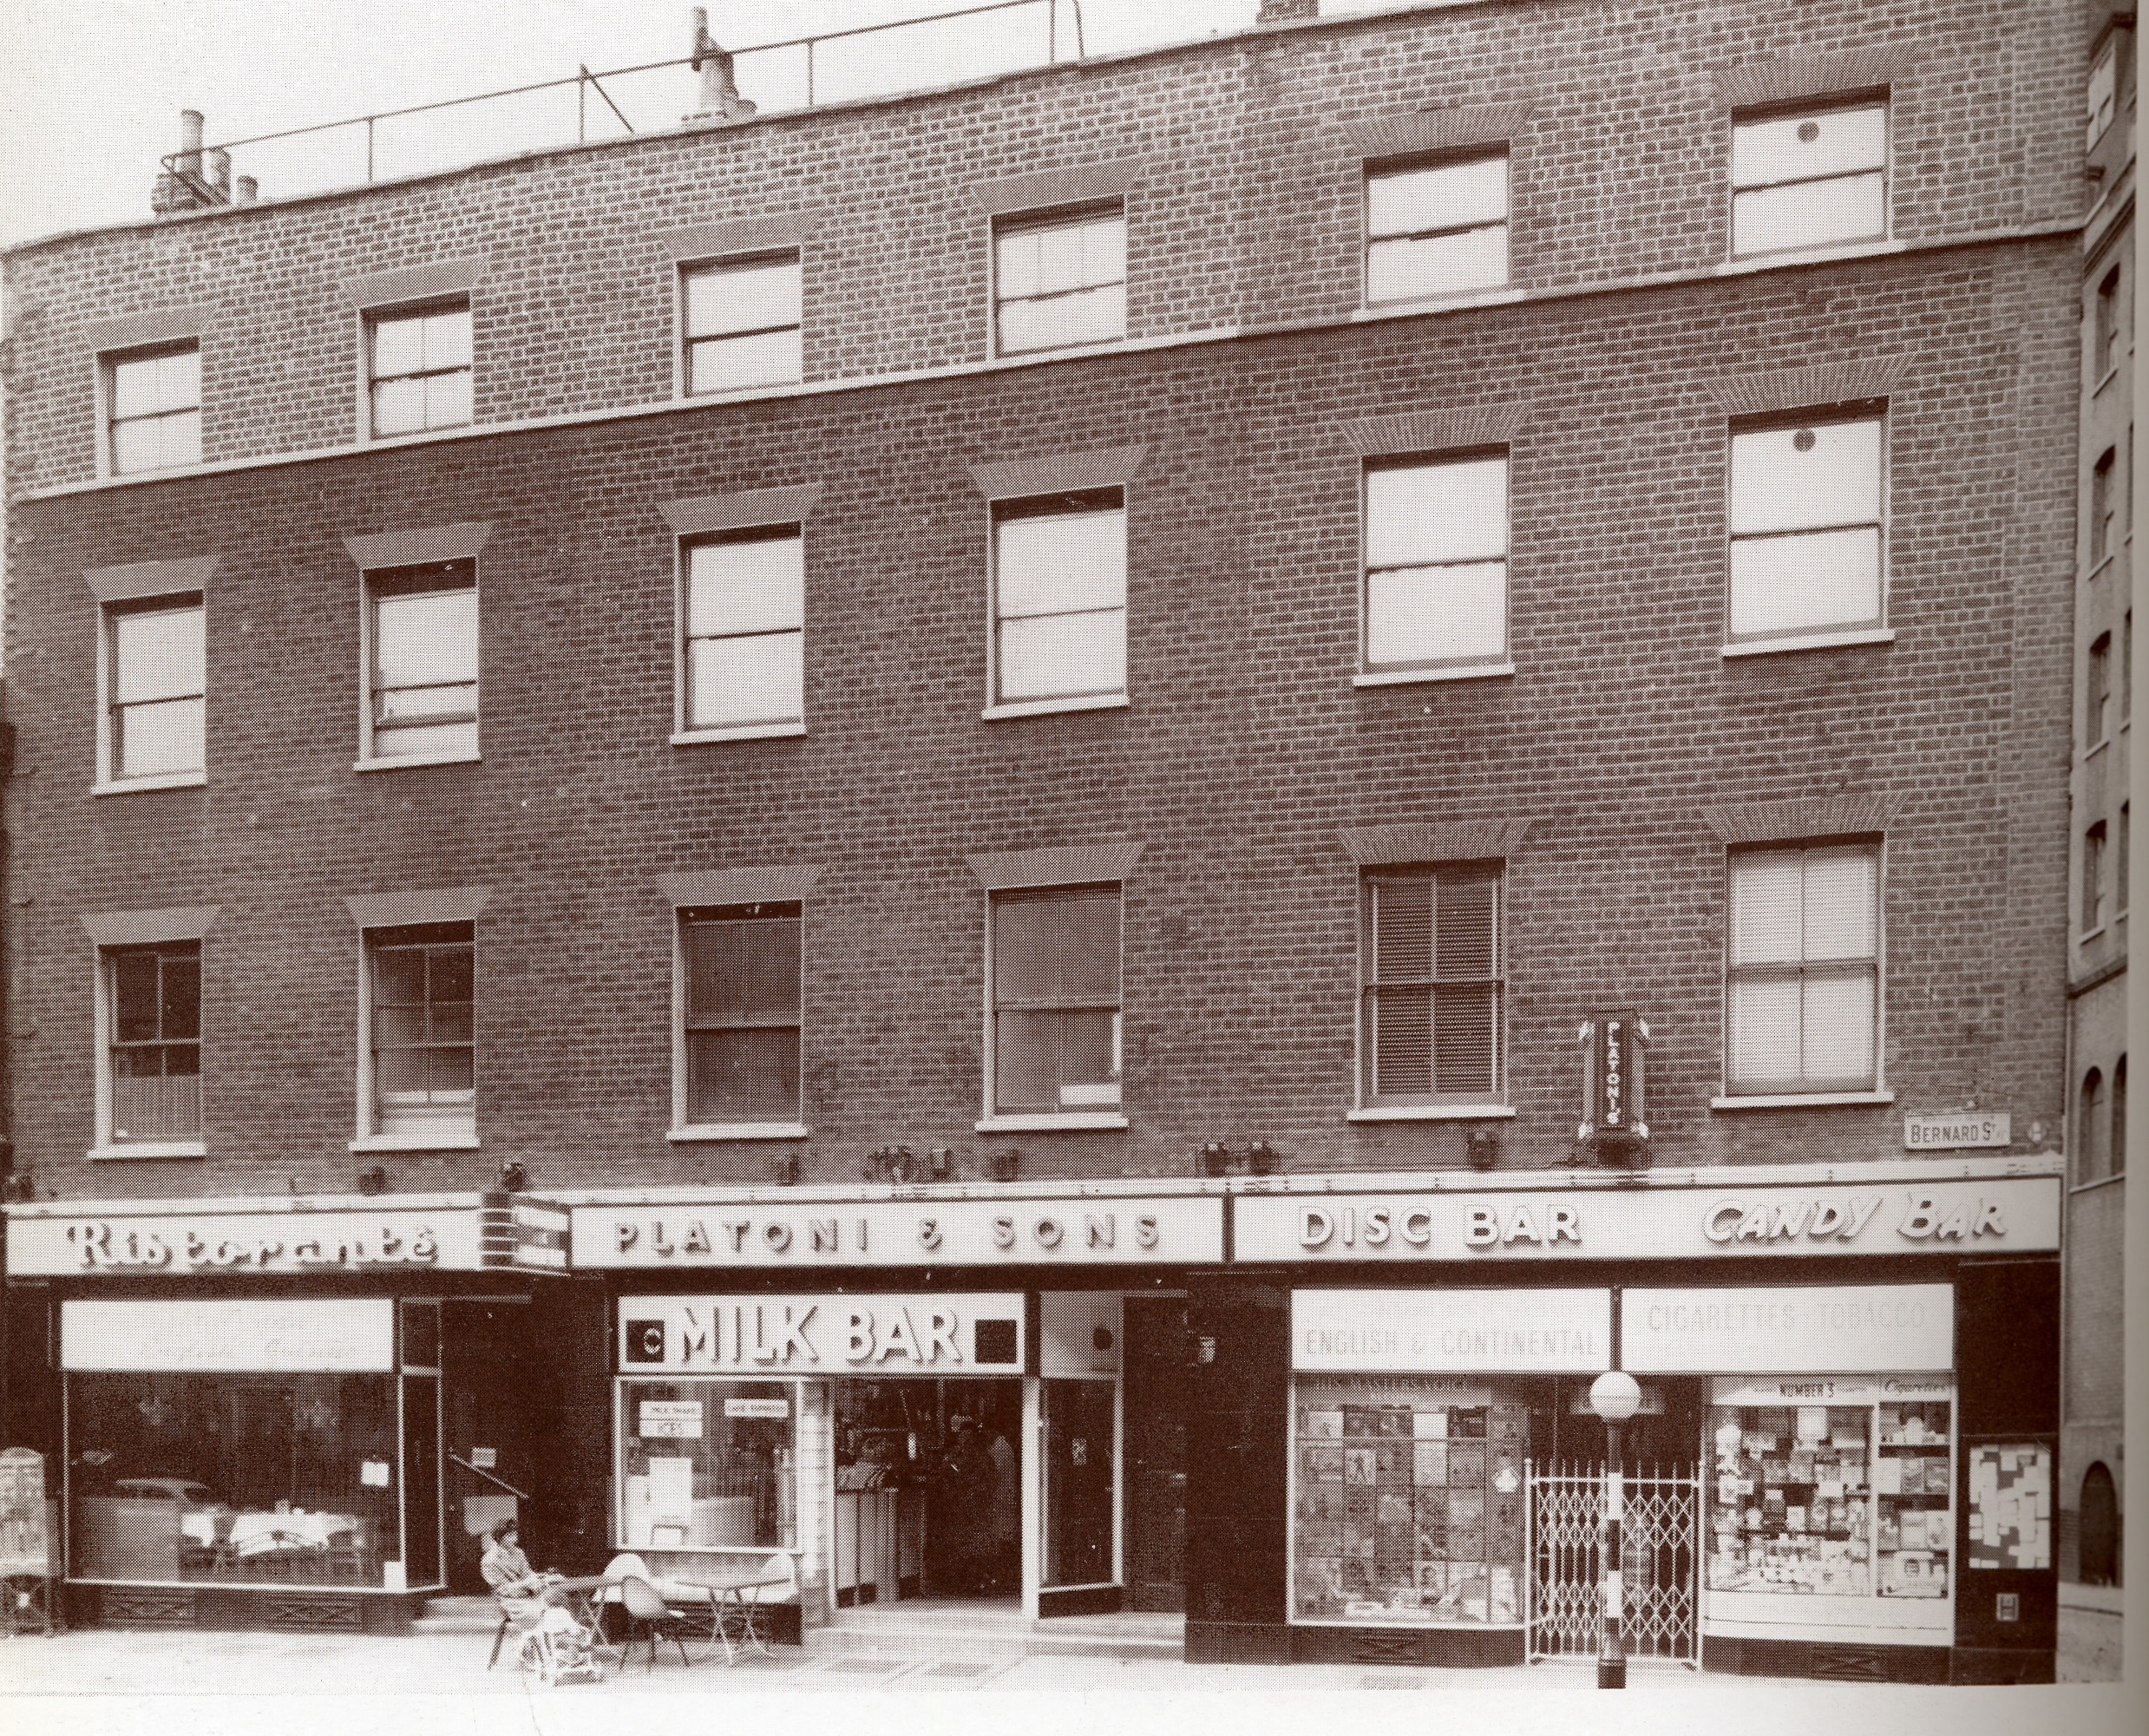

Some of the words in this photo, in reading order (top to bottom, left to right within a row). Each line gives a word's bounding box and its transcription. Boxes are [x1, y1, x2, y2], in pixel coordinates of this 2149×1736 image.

[1911, 1124, 1978, 1143] BERNARD
[615, 1220, 870, 1255] PLATONI
[917, 1218, 942, 1250] &
[993, 1215, 1160, 1251] SONS
[1301, 1204, 1432, 1251] DISC
[1465, 1203, 1584, 1250] BAR
[1702, 1196, 1884, 1244] CANDY
[1897, 1192, 2008, 1241] BAR
[66, 1222, 436, 1267] Ristorante
[1647, 1303, 1796, 1332] CIGARETTES
[1818, 1301, 1925, 1329] TOBACCO
[682, 1305, 820, 1366] MILK
[844, 1305, 963, 1366] BAR
[1304, 1329, 1399, 1356] ENGLISH
[1441, 1328, 1598, 1355] CONTINENTAL
[1315, 1378, 1342, 1392] HIS
[1425, 1378, 1470, 1392] VOICE
[1779, 1384, 1825, 1398] NUMBER
[1827, 1383, 1834, 1398] 3
